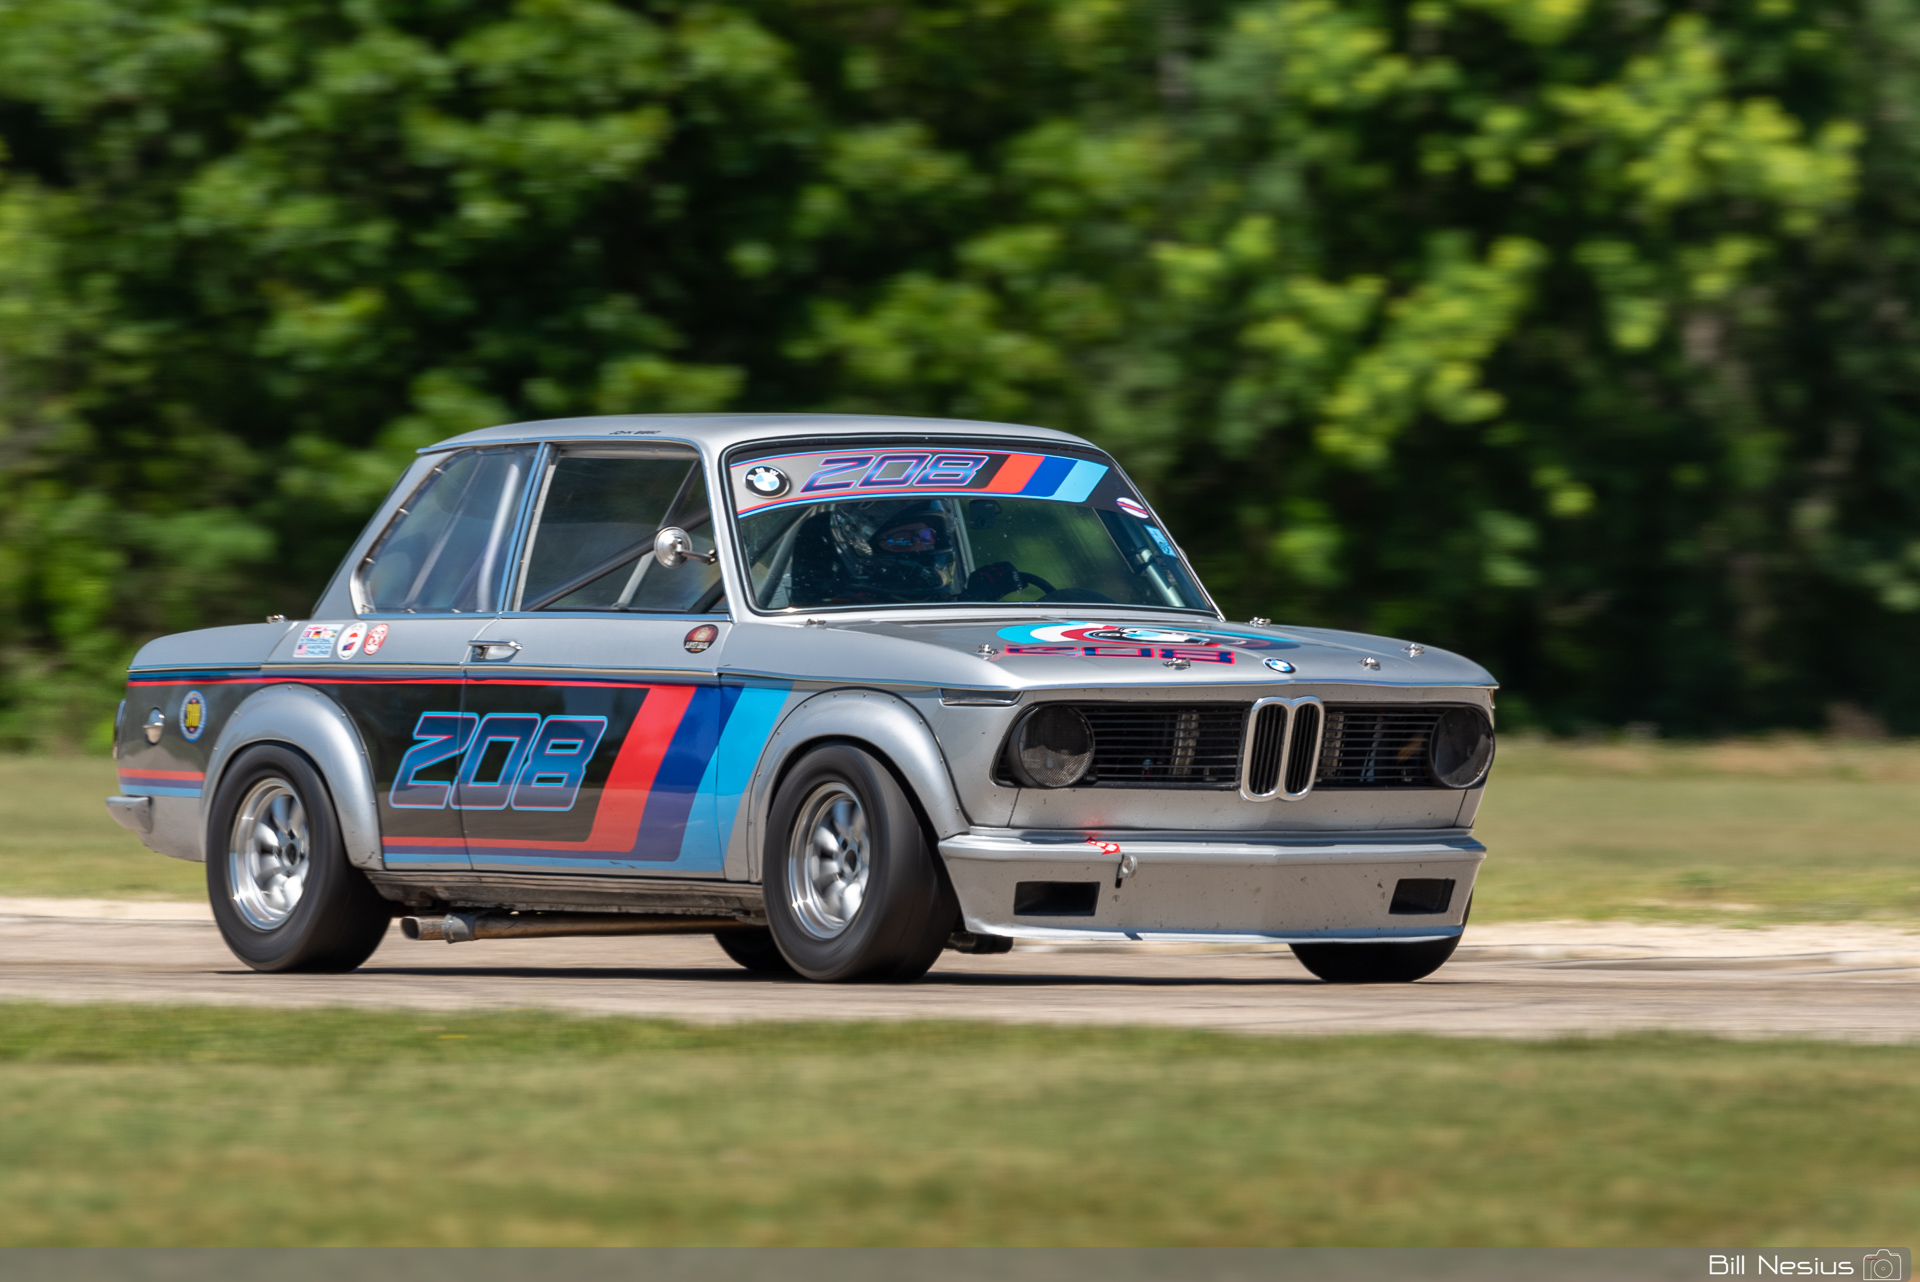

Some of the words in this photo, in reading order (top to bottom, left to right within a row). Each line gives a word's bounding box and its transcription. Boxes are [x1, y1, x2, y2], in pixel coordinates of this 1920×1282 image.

[747, 467, 779, 480] BMW
[799, 453, 990, 493] 208
[388, 711, 608, 812] 208
